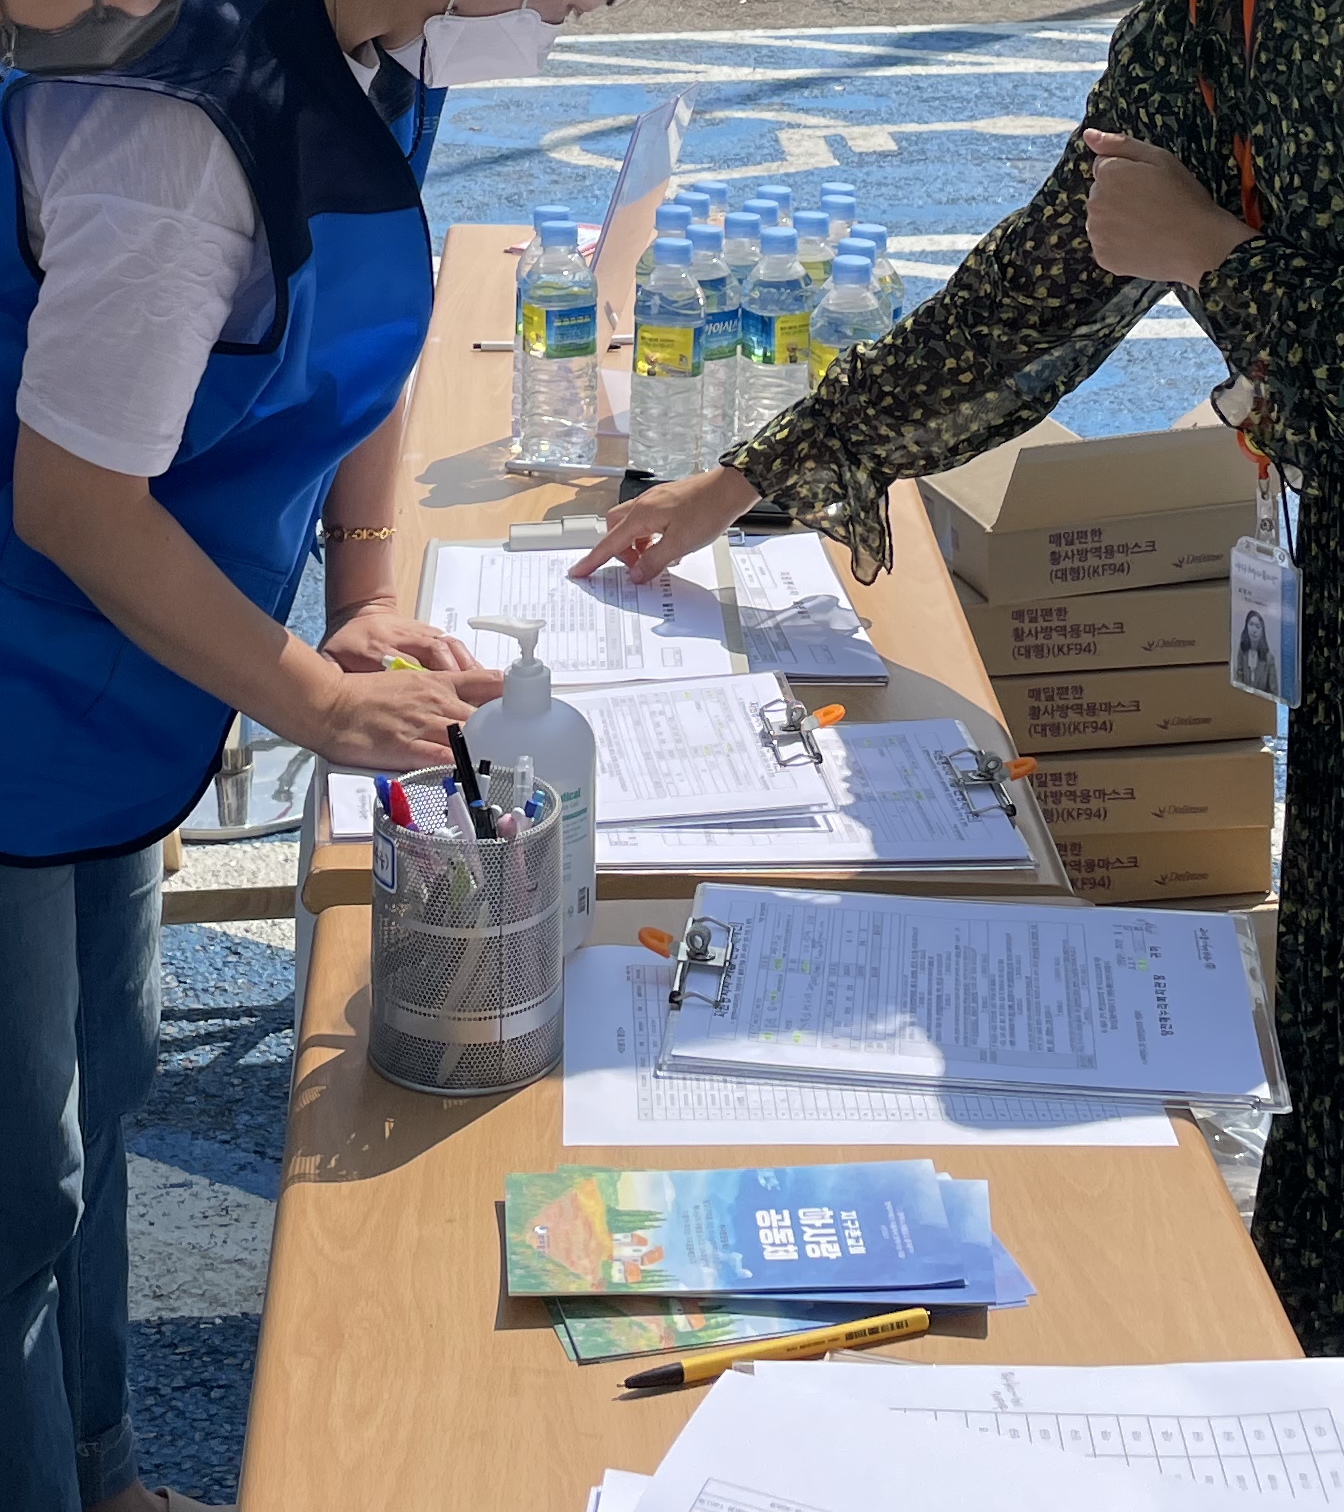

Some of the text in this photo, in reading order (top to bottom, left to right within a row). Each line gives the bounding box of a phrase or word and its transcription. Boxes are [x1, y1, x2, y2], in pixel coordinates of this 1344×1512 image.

[1049, 527, 1103, 546] 매일편한
[1049, 541, 1158, 567] 황사방역용마스크
[1049, 562, 1132, 584] (대형)(KF94)
[1011, 606, 1068, 624] 매일편한
[1012, 621, 1126, 641] 황사방역용마스크
[1012, 640, 1098, 660] (대형)(KF94)
[1028, 684, 1084, 702] 매일편한
[1028, 699, 1142, 720] 황사방역용마스크
[1028, 717, 1114, 738] (대형)(KF94)
[1036, 787, 1136, 805] 사방역용마스크
[1044, 806, 1108, 824] 형)(KF94)
[1057, 841, 1082, 857] 편한
[1064, 856, 1139, 874] 역용마스크
[755, 1208, 799, 1262] 공동체
[798, 1206, 842, 1260] 하사랑
[841, 1210, 867, 1257] 지구촌교회
